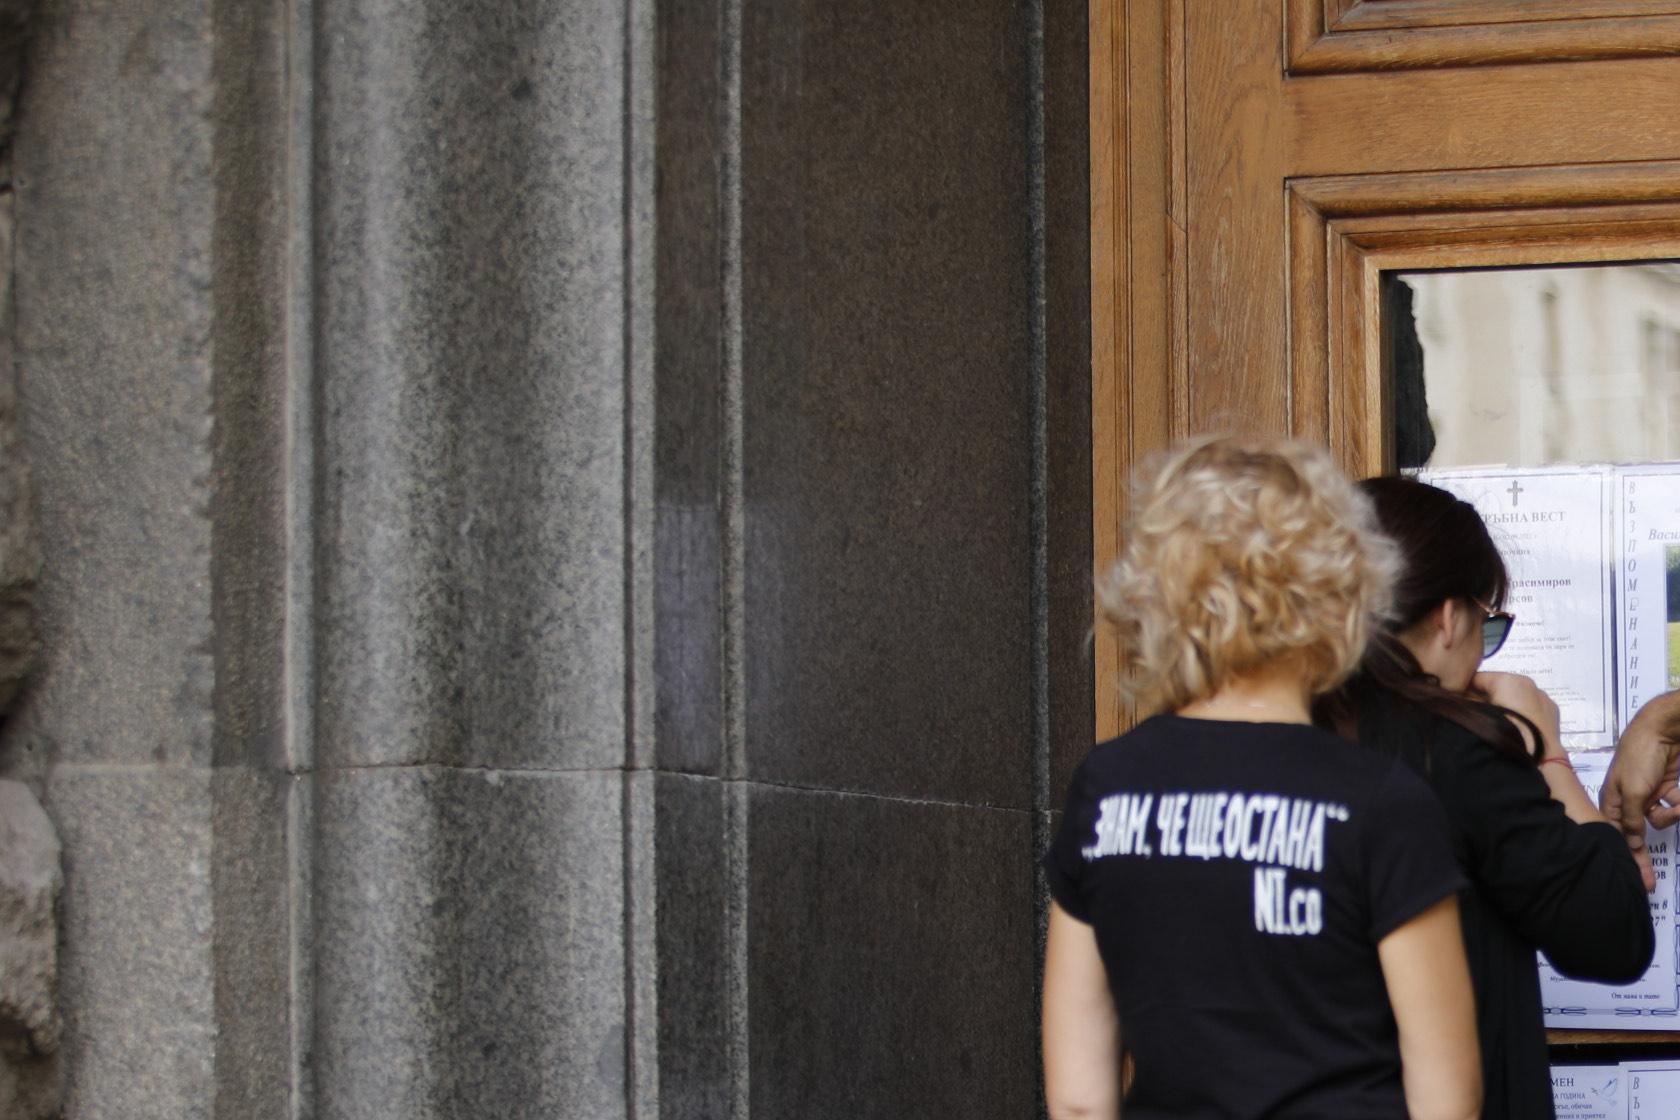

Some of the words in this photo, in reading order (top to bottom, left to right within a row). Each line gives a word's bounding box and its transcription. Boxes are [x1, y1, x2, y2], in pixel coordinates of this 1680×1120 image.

[1480, 512, 1529, 524] РЪБНА
[1532, 511, 1566, 523] ВЕСТ
[1511, 578, 1572, 590] расимиров
[1508, 595, 1534, 605] рсов
[1551, 1078, 1575, 1088] МЕН
